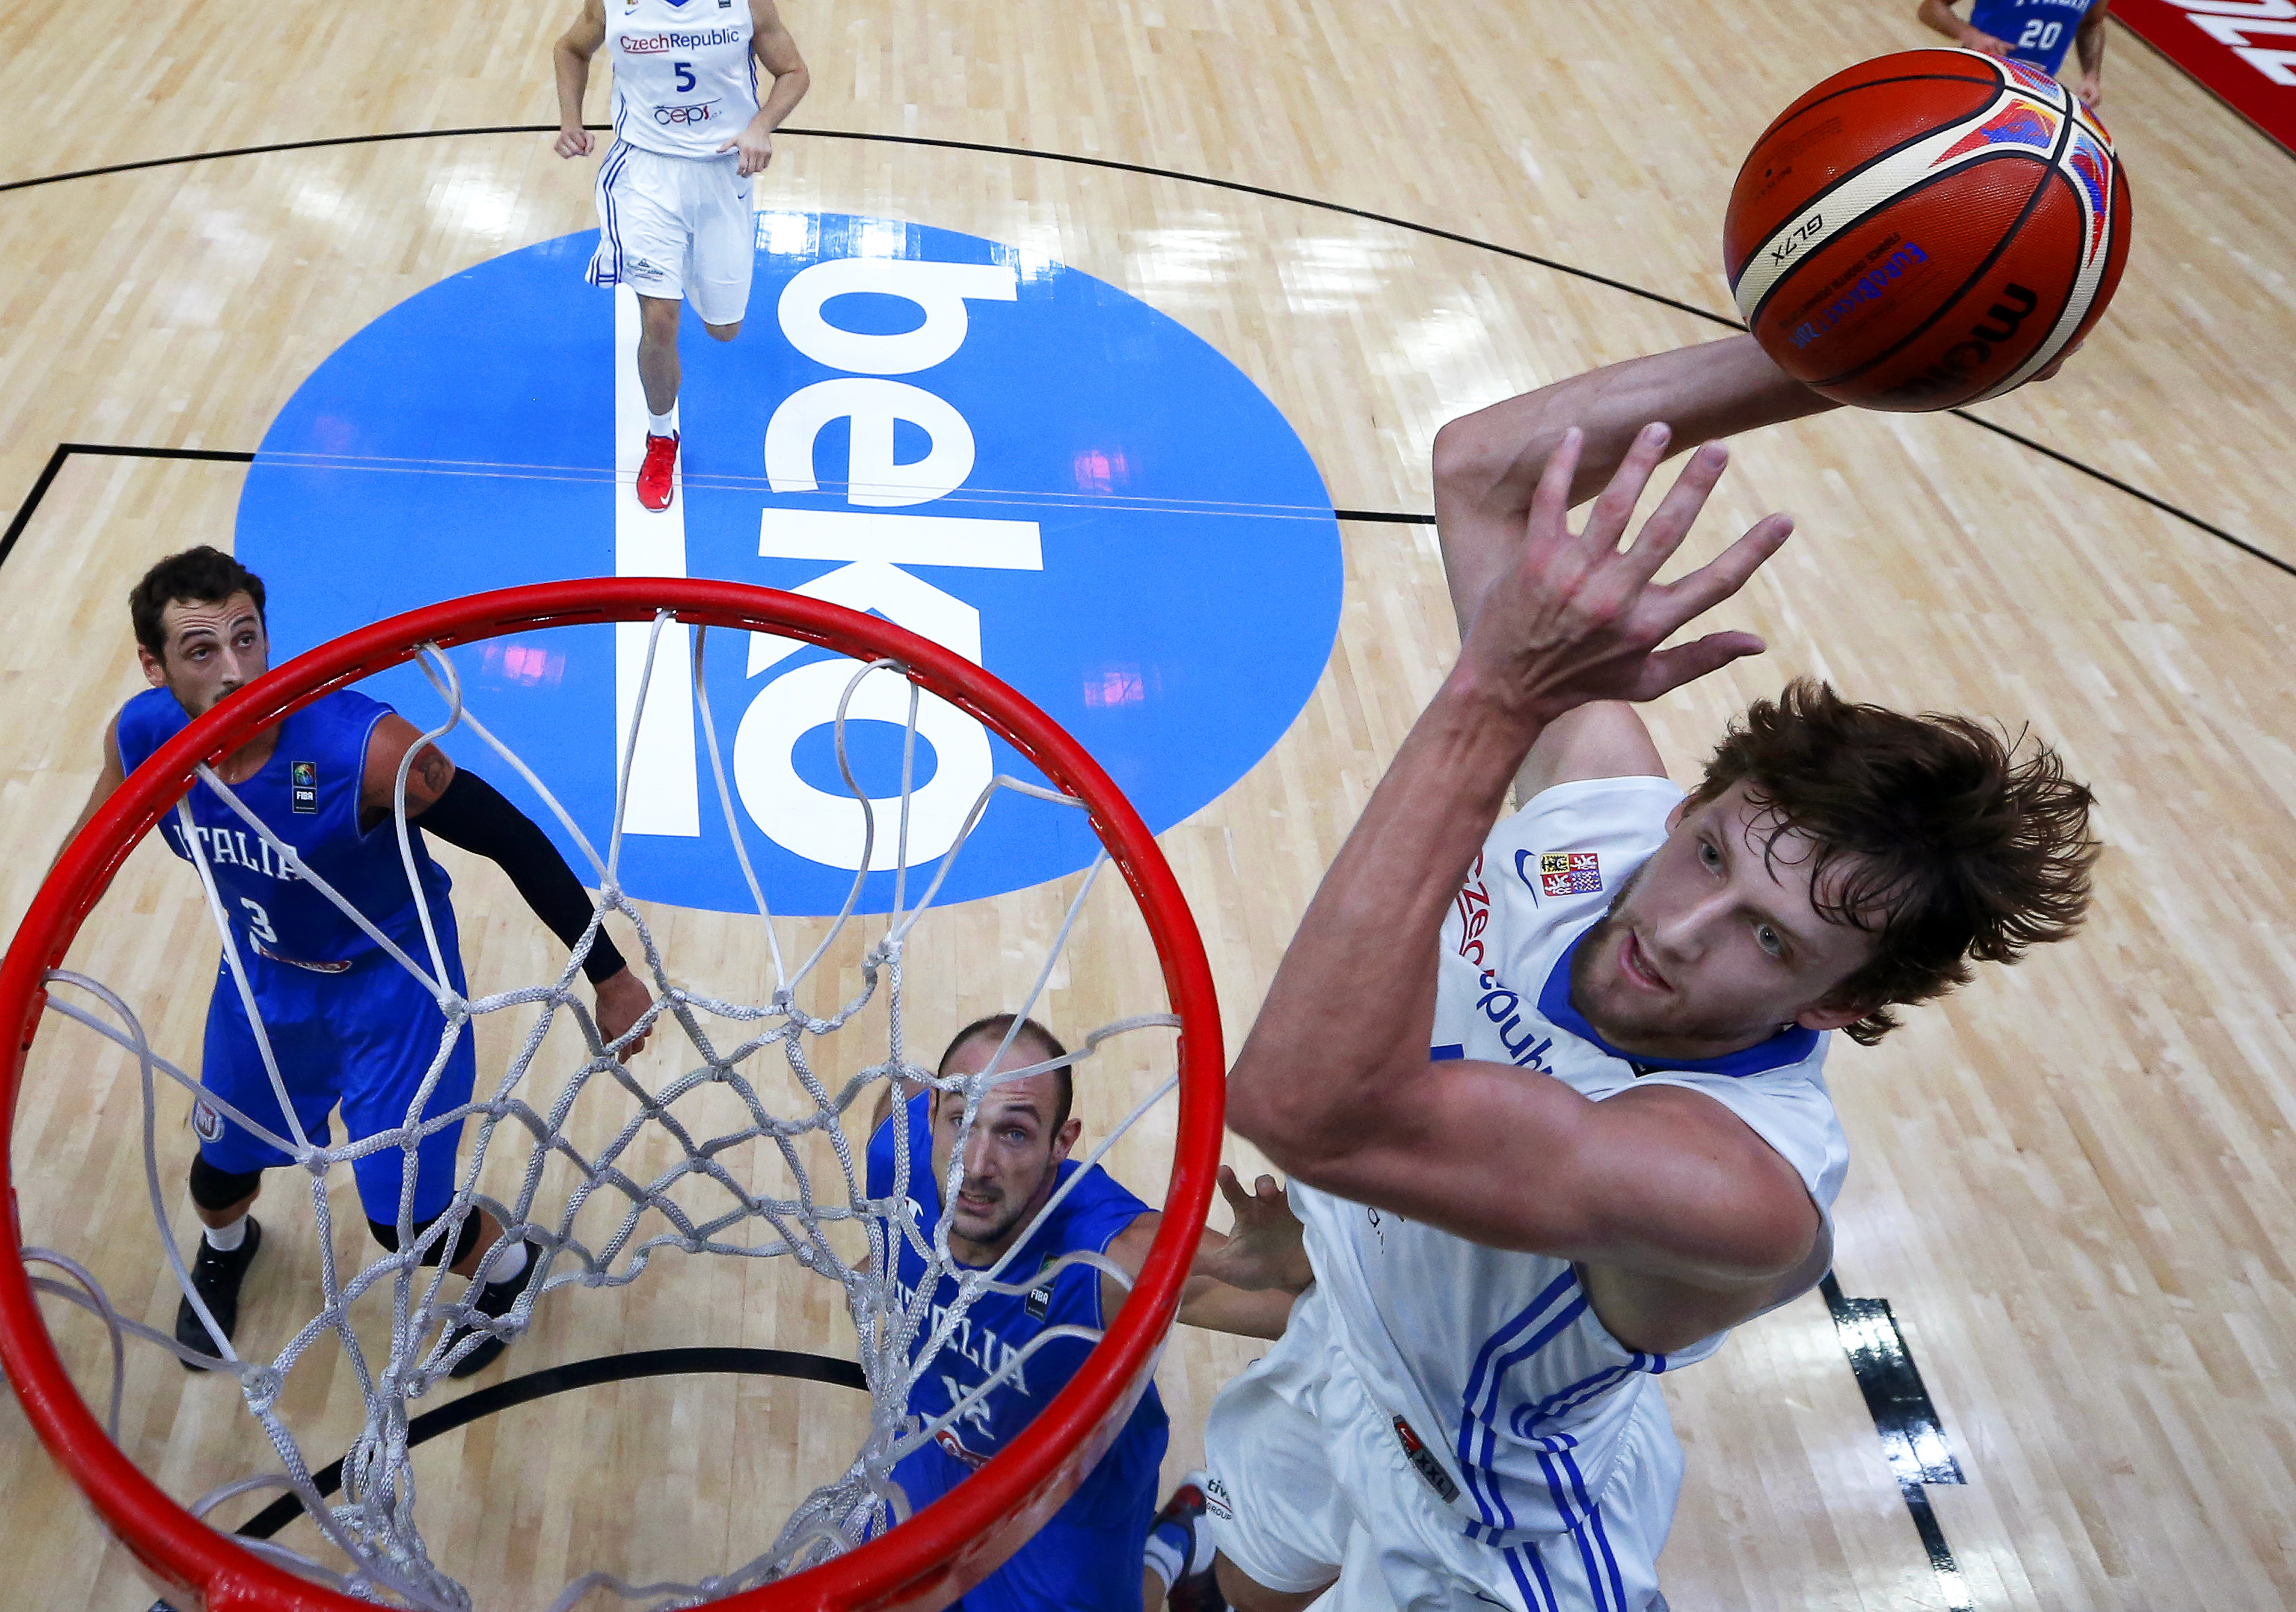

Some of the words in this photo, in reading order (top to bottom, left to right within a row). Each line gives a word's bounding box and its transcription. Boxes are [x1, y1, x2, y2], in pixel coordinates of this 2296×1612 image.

[2018, 19, 2064, 50] 20
[675, 62, 696, 92] 5
[1772, 214, 1824, 266] GL7X
[733, 257, 1044, 872] beko
[296, 791, 313, 800] FIBA
[1031, 1289, 1048, 1305] FIBA
[1416, 1453, 1447, 1492] XXL
